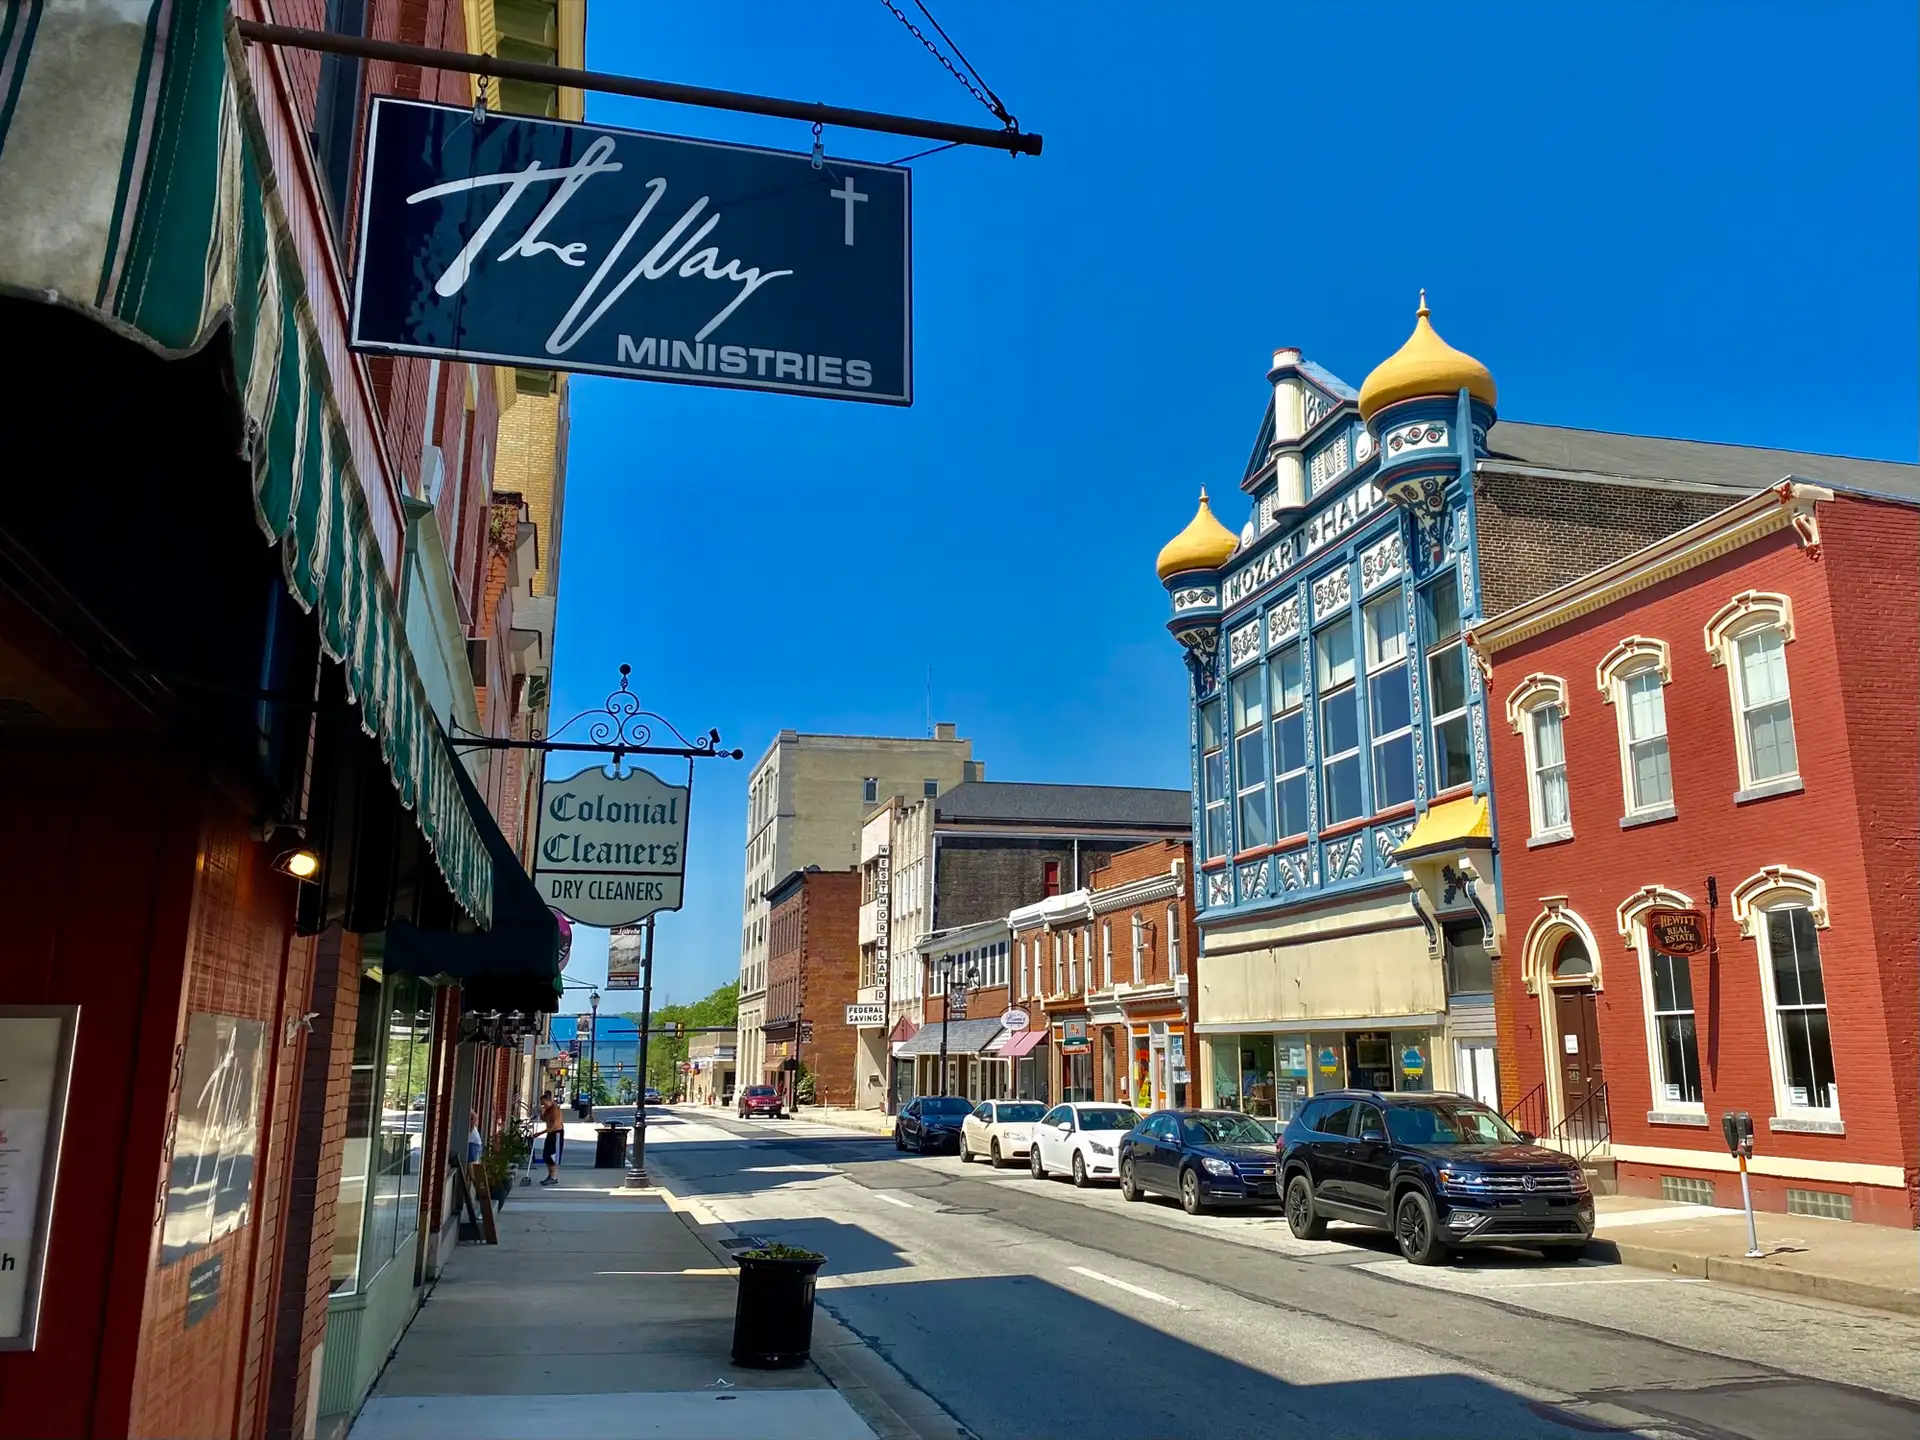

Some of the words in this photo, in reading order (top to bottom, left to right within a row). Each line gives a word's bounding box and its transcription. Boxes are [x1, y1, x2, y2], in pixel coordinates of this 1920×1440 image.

[406, 136, 623, 297] The
[546, 177, 793, 353] Way
[617, 334, 873, 387] MINISTRIES
[1229, 528, 1305, 605] MOZART
[550, 792, 678, 824] Colonial
[543, 833, 679, 865] Cleaners
[551, 880, 583, 899] DRY
[588, 881, 663, 901] CLEANERS
[878, 846, 888, 999] WESTMORELAND
[1660, 915, 1696, 928] HEWITT
[1667, 925, 1690, 936] REAL
[1664, 933, 1696, 944] ESTATE
[848, 1006, 883, 1014] FEDERAL
[848, 1014, 883, 1022] SAVINGS
